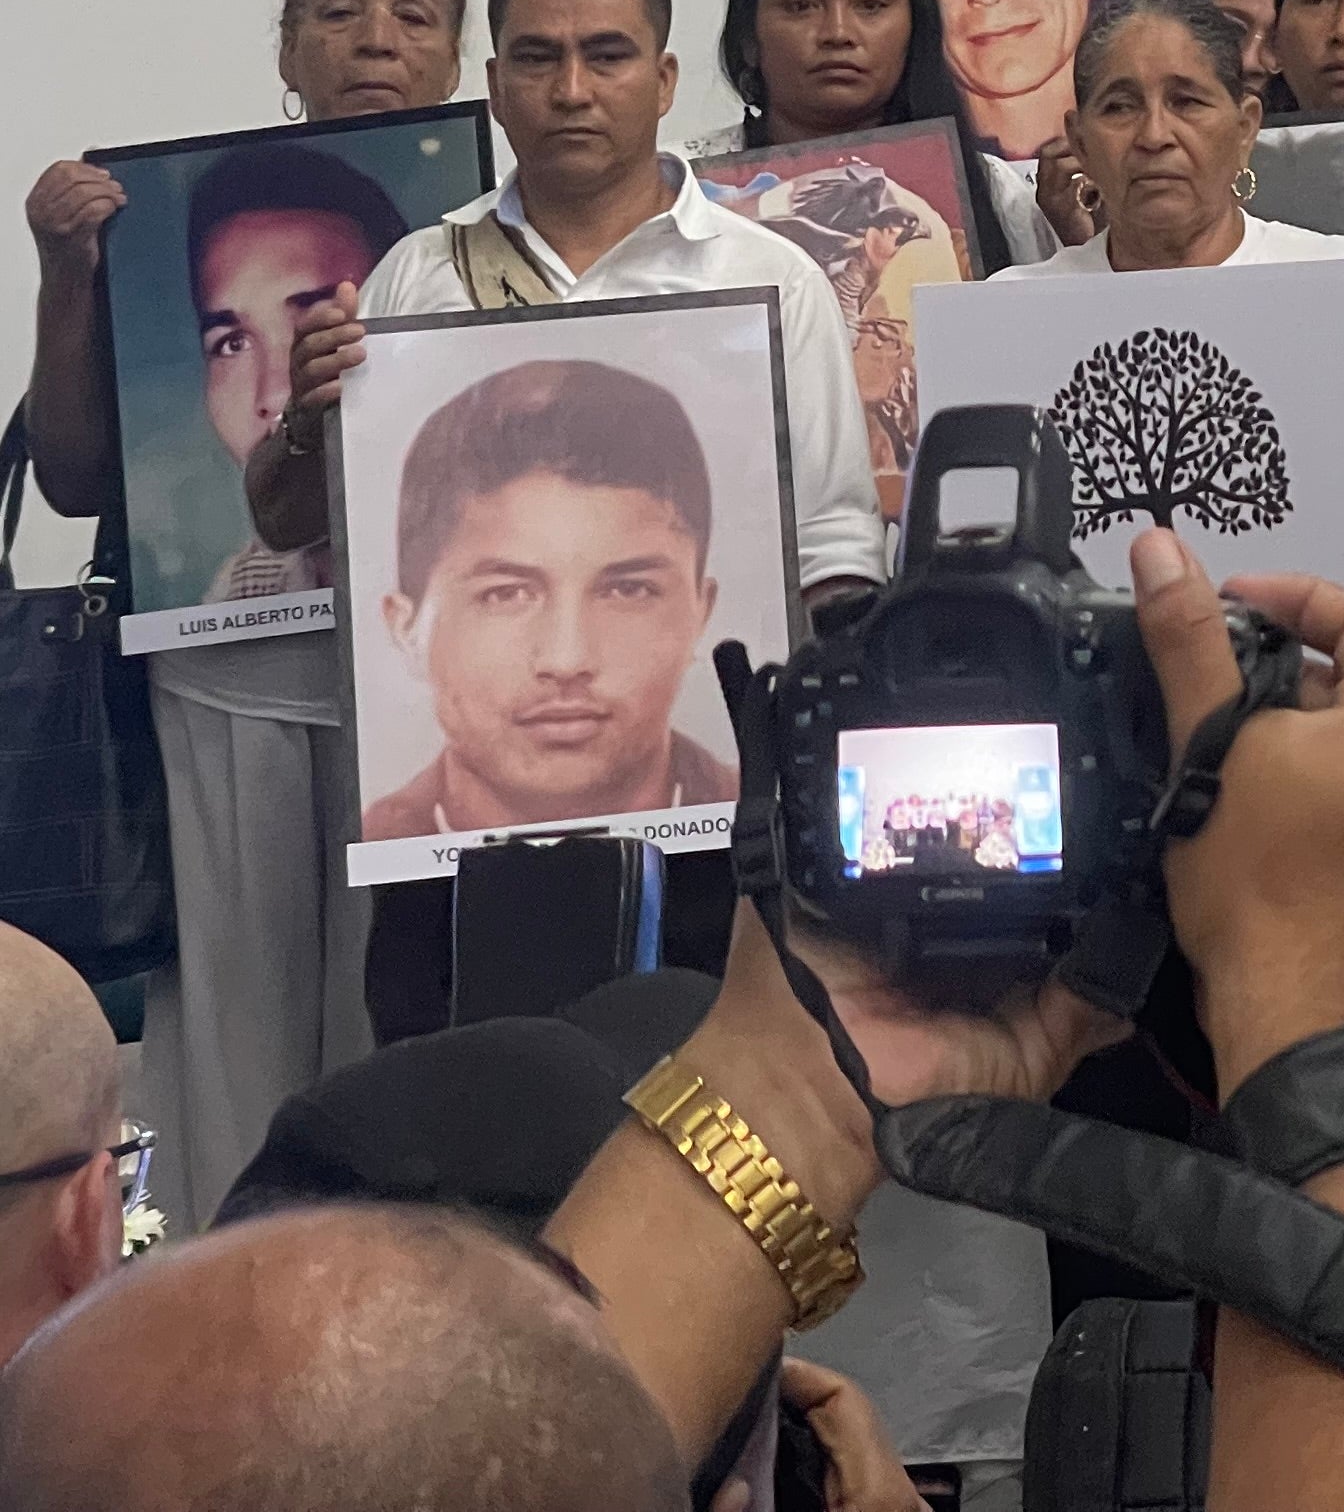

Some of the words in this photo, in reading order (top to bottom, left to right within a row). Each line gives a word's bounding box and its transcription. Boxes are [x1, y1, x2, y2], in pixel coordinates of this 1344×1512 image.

[179, 617, 218, 635] LUIS
[222, 606, 304, 629] ALBERTO
[643, 817, 731, 840] DONADO
